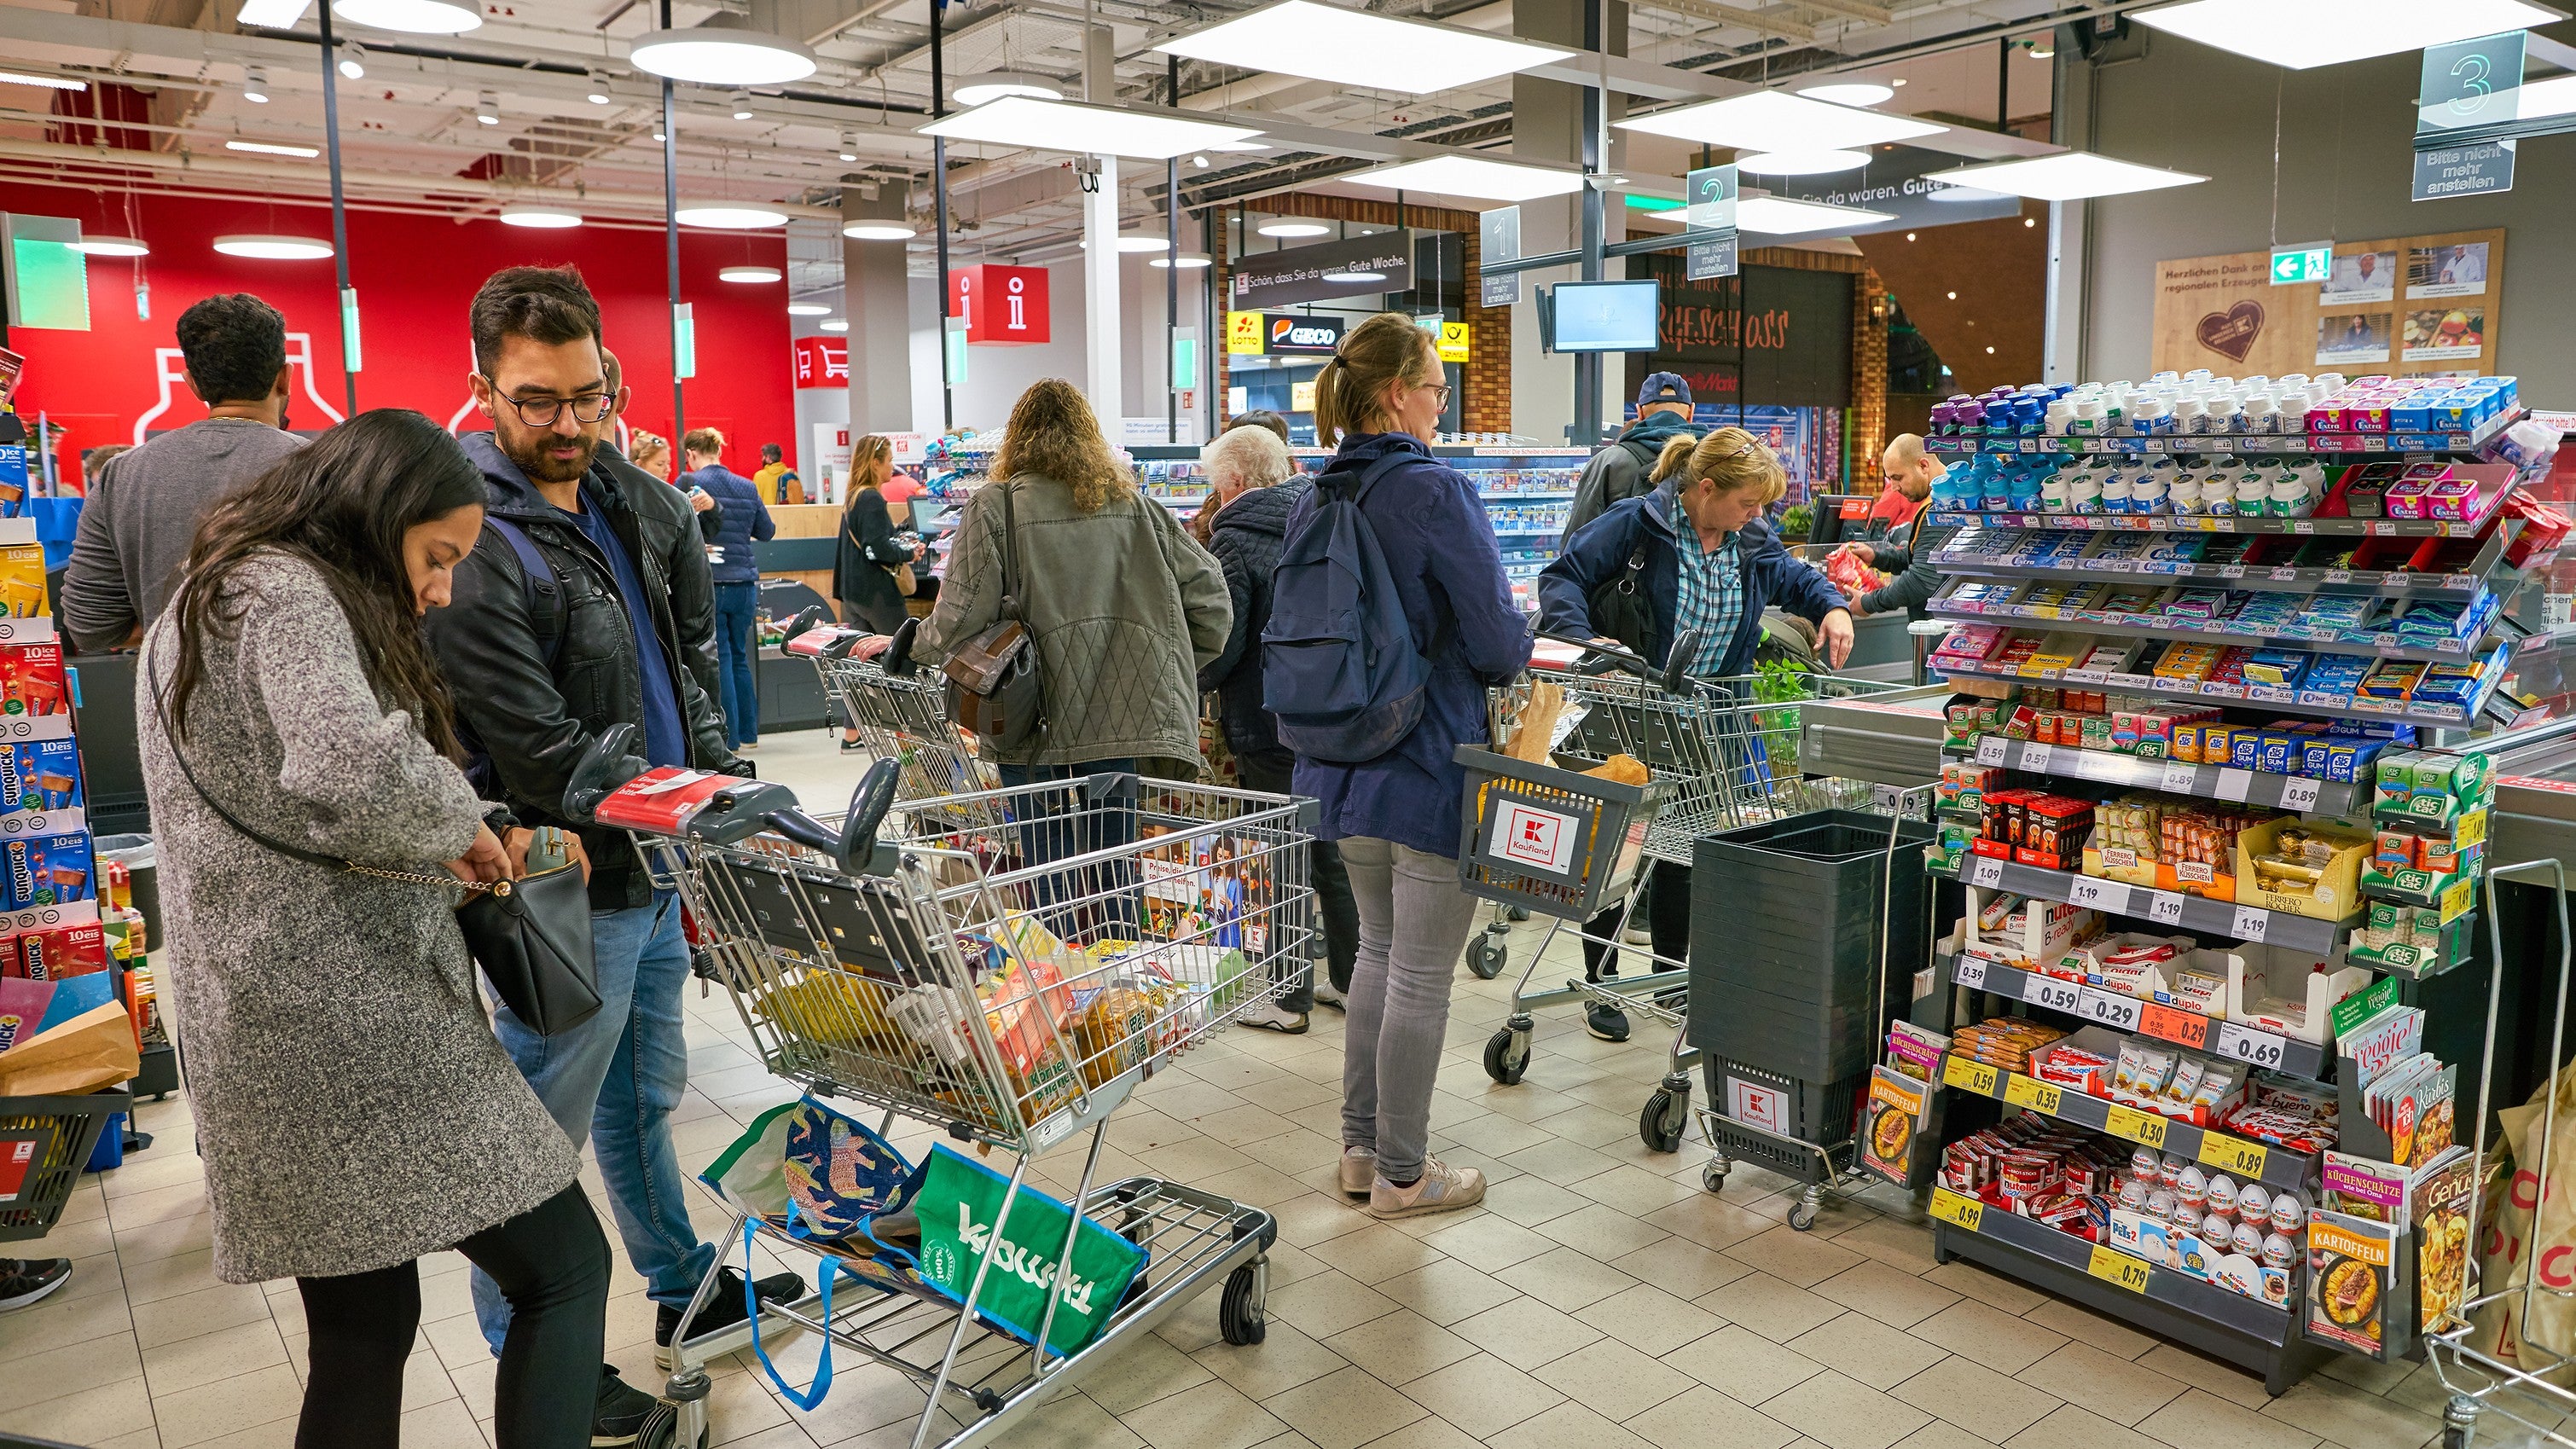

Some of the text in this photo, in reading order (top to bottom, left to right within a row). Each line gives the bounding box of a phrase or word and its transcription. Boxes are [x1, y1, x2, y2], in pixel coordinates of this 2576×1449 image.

[2447, 54, 2491, 115] 3
[2427, 145, 2502, 166] Bitte nicht
[2442, 162, 2483, 178] mehr
[1825, 190, 1844, 206] da
[1848, 185, 1899, 203] waren.
[1902, 177, 1944, 195] Gute
[2427, 176, 2495, 194] anstellen
[1700, 177, 1724, 223] 2
[1494, 217, 1506, 256] 1
[1693, 241, 1731, 257] Bitte nicht
[1702, 254, 1722, 265] mehr
[1249, 274, 1273, 288] Schön,
[1274, 272, 1293, 284] dass
[1294, 269, 1307, 281] Sie
[1308, 267, 1319, 279] da
[1349, 260, 1371, 272] Gute
[1372, 254, 1407, 269] Woche.
[1695, 264, 1728, 276] anstellen
[2165, 267, 2219, 280] Herzlichen
[2221, 264, 2248, 275] Dank
[1500, 274, 1516, 284] nicht
[1493, 286, 1508, 294] mehr
[2165, 281, 2219, 293] regionalen
[1659, 302, 1789, 352] RGESCHOSS
[1233, 337, 1258, 345] LOTTO
[1290, 327, 1336, 345] GECO
[2317, 420, 2340, 431] Extra
[2358, 420, 2381, 431] Extra
[2369, 438, 2384, 447] 2,99
[2399, 622, 2452, 635] Airwaves
[2378, 635, 2395, 644] 0,75
[2442, 640, 2459, 648] 0,75
[24, 647, 42, 658] 10
[2331, 697, 2347, 705] 0,55
[2386, 702, 2402, 710] 1,99
[41, 742, 56, 753] 10
[1982, 748, 2005, 759] 0.59
[2025, 753, 2047, 765] 0.59
[2237, 755, 2254, 763] GUM
[2168, 774, 2193, 785] 0.89
[2289, 790, 2317, 803] 0.89
[2416, 805, 2438, 815] tac
[2421, 798, 2440, 809] tic
[52, 837, 67, 848] 10
[1512, 839, 1550, 857] Kaufland
[2104, 855, 2134, 867] KÜSSCHEN
[2106, 849, 2132, 860] FERRERO
[1980, 867, 1999, 879] 1.09
[2179, 868, 2211, 882] KÜSSCHEN
[2181, 863, 2208, 874] FERRERO
[2078, 886, 2097, 899] 1.19
[2266, 893, 2302, 907] FERRERO
[2159, 901, 2180, 915] 1.19
[2266, 901, 2301, 914] ROCHER
[2242, 918, 2265, 932] 1.19
[68, 930, 100, 942] 10 eis
[1967, 949, 1992, 960] nutella
[1963, 967, 1984, 980] 0.39
[2103, 978, 2133, 992] duplo
[2040, 988, 2076, 1008] 0.59
[2171, 996, 2202, 1011] duplo
[2096, 1001, 2133, 1024] 0.29
[2148, 1028, 2163, 1037] -17%
[2181, 1022, 2205, 1042] 0.29
[2238, 1039, 2280, 1064] 0.69
[1973, 1070, 1993, 1092] 0.59
[1874, 1085, 1917, 1113] KARTOFFELN
[2035, 1088, 2058, 1110] 0.35
[2271, 1097, 2312, 1112] bueno
[1743, 1111, 1772, 1126] Kaufland
[2256, 1116, 2301, 1133] bueno
[2139, 1121, 2163, 1143] 0.30
[2237, 1150, 2261, 1174] 0.89
[2005, 1179, 2039, 1191] nutella
[2326, 1169, 2401, 1198] KÜCHENSCHÄTZE
[2366, 1189, 2383, 1199] Oma
[1958, 1204, 1979, 1226] 0.99
[2314, 1232, 2385, 1263] KARTOFFELN
[2122, 1264, 2146, 1288] 0.79
